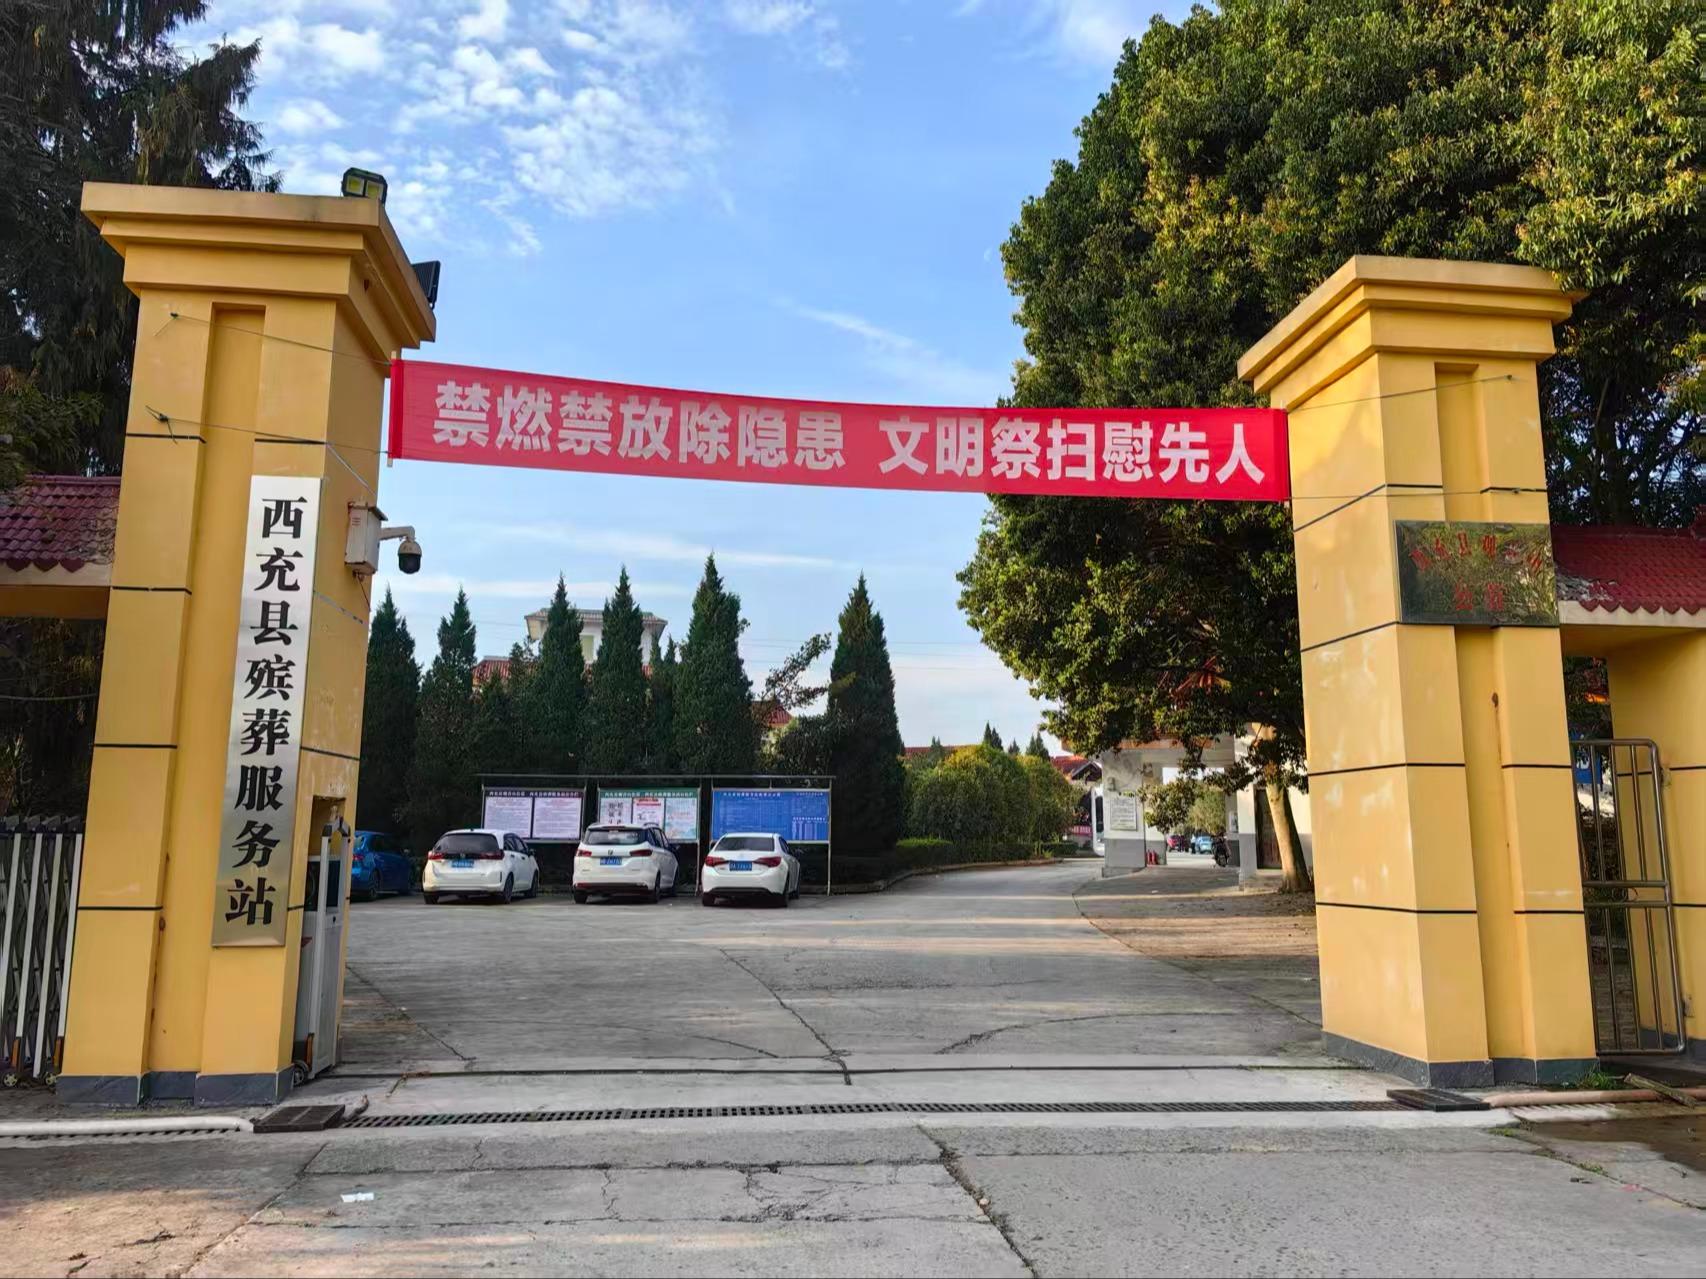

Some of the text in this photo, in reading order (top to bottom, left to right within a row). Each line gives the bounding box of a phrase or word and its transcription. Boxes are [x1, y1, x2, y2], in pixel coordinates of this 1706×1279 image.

[433, 380, 1265, 485] 禁燃禁放除隐患 文明祭扫慰先人
[225, 496, 308, 927] 西充县殡葬服务站
